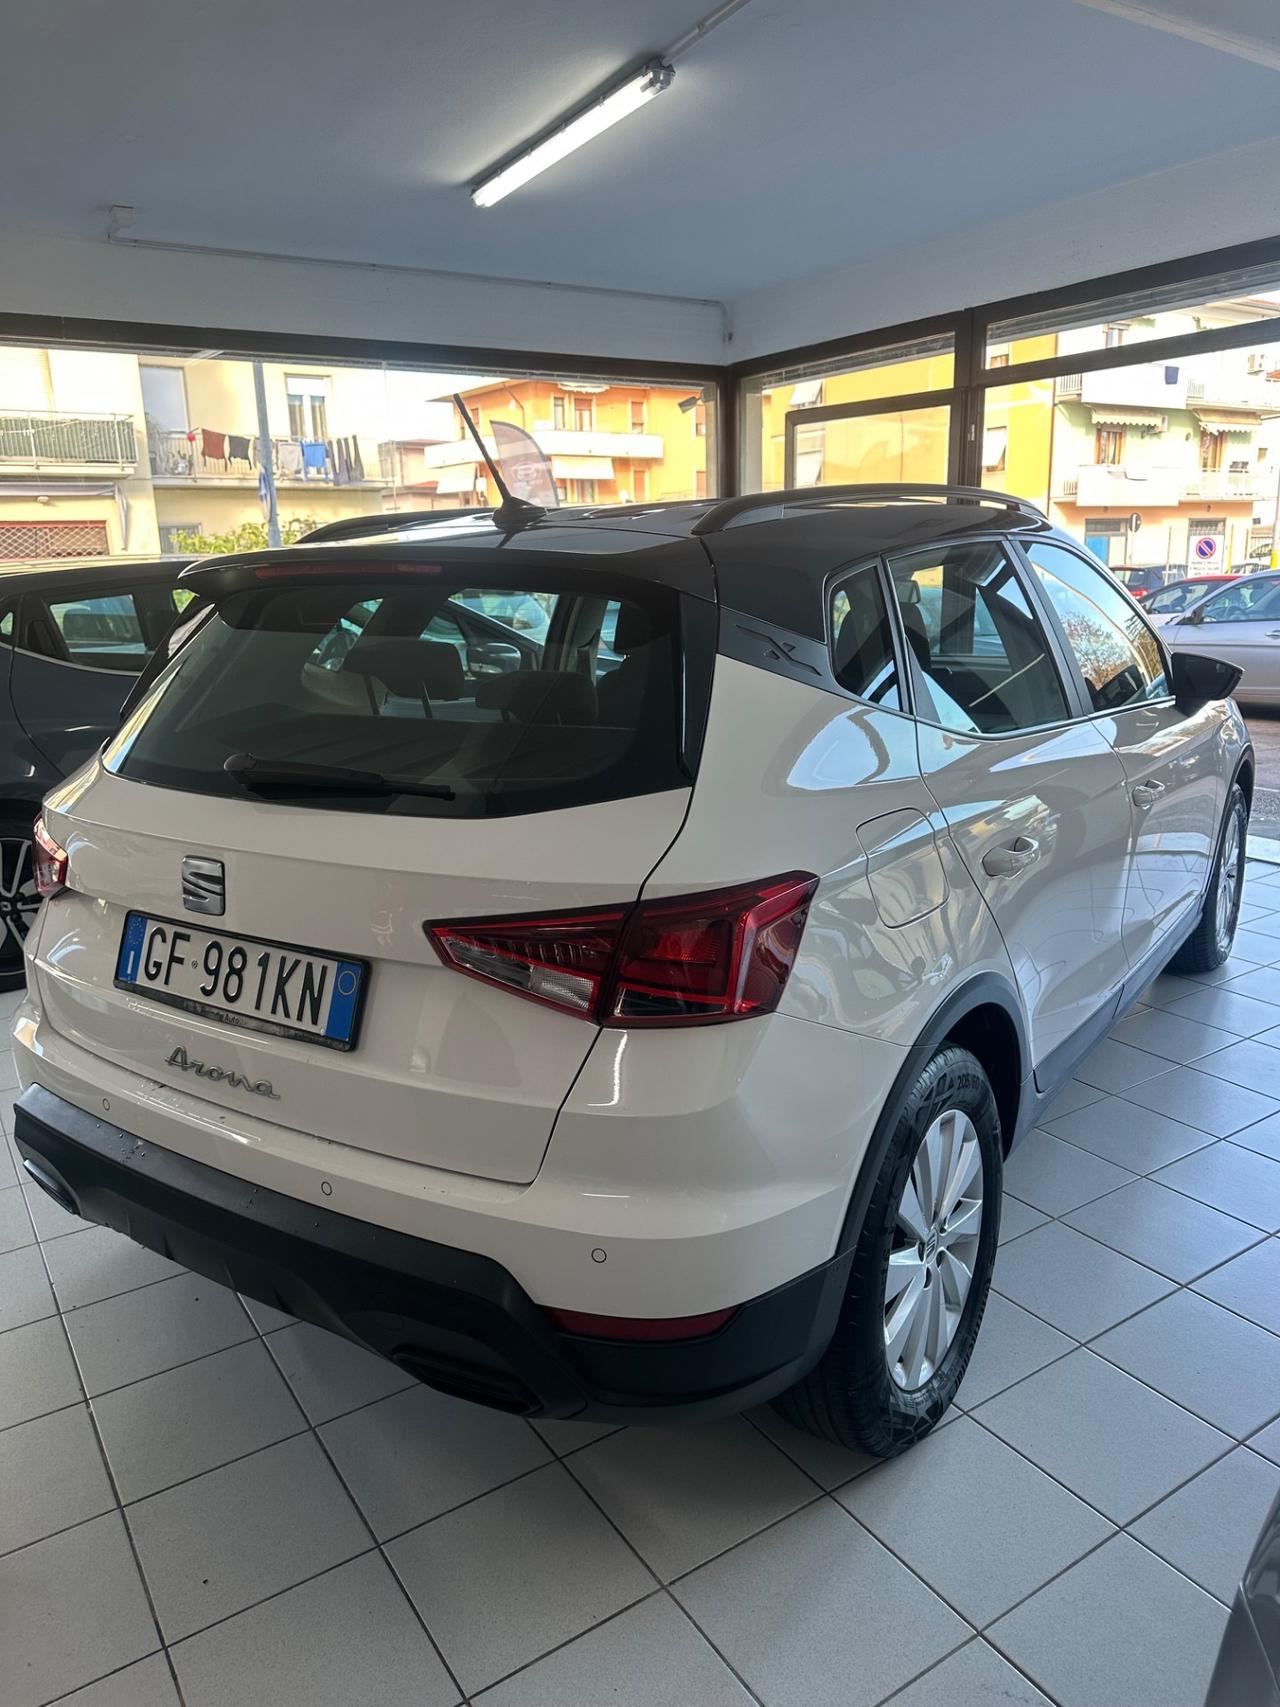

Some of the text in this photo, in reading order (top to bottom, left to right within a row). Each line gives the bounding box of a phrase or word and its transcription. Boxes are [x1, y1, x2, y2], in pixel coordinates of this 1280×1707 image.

[127, 951, 135, 974] I
[145, 928, 328, 1025] GF 981KN
[164, 1045, 281, 1099] Arona
